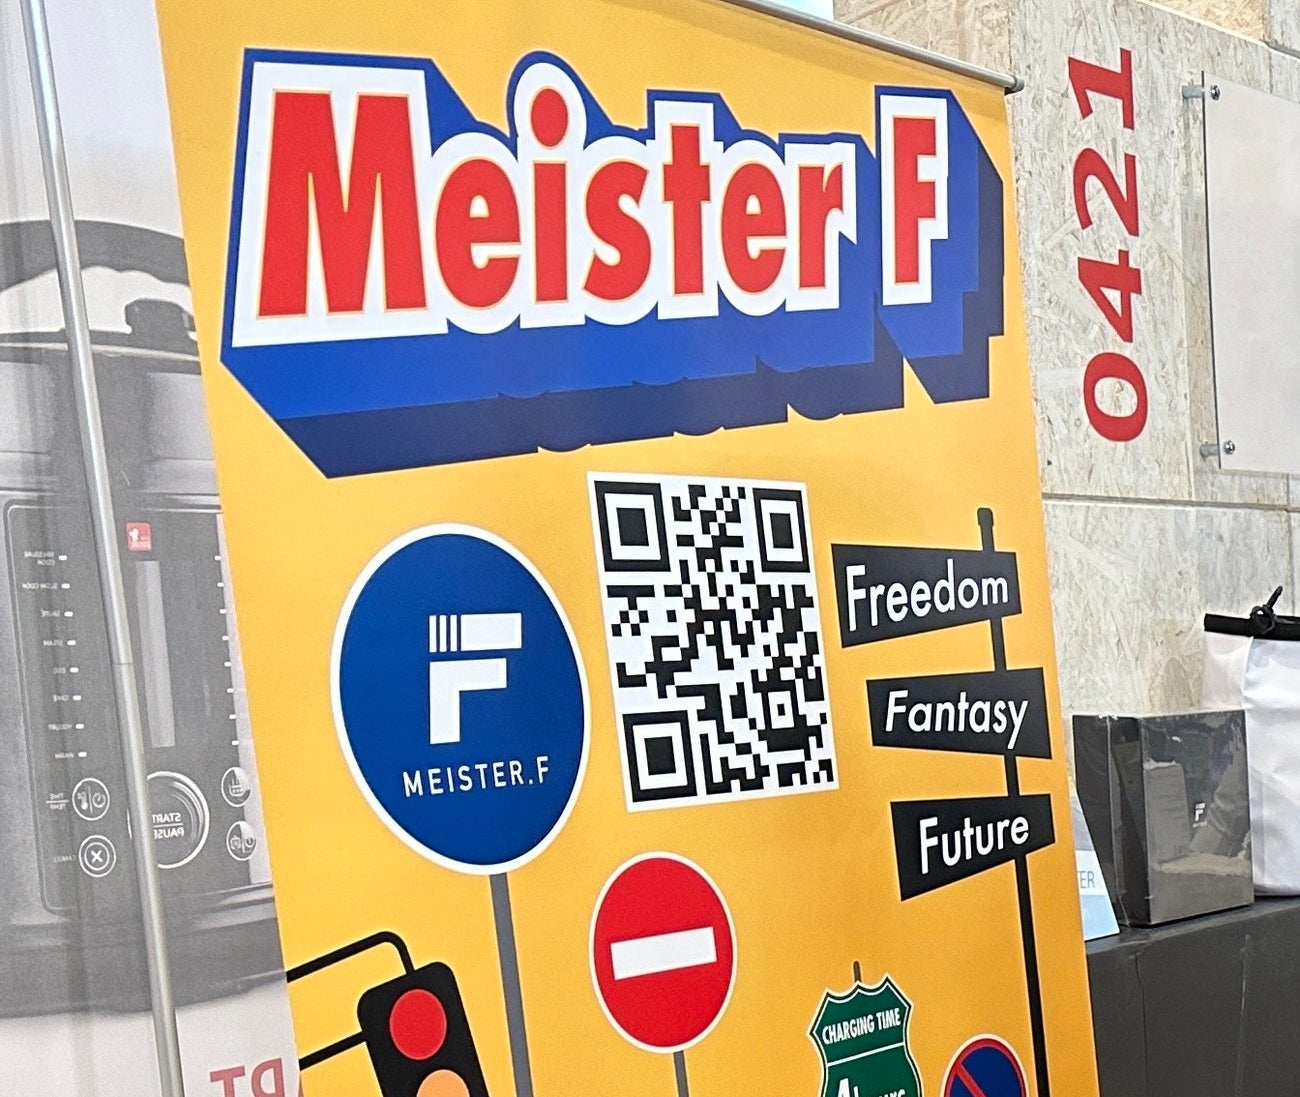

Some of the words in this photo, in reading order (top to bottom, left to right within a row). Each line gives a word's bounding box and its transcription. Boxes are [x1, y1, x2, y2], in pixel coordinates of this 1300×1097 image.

[247, 77, 851, 330] Meister
[888, 106, 942, 294] F
[1067, 47, 1149, 443] 0421
[844, 556, 1010, 634] Freedom
[883, 688, 1029, 752] Fantasy
[401, 755, 551, 798] MEISTER.F
[918, 813, 1031, 876] Future
[1077, 870, 1096, 889] ER
[820, 1014, 874, 1047] CHARGING
[875, 1006, 902, 1031] TIME
